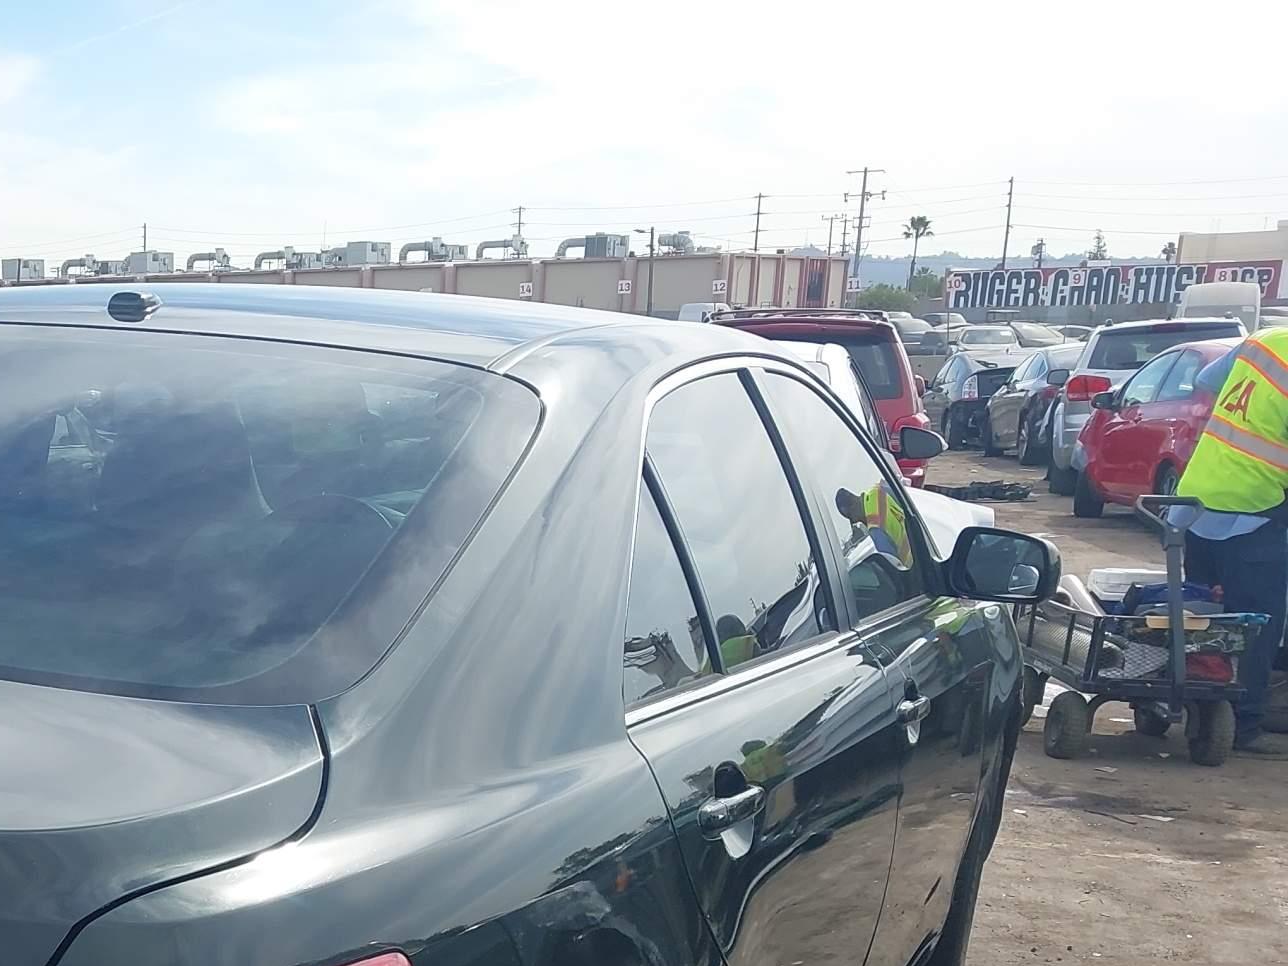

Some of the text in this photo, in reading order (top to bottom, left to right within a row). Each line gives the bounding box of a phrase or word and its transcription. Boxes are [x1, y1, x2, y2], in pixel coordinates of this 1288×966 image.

[1072, 273, 1081, 285] 9
[1218, 270, 1227, 282] 8
[619, 282, 631, 292] 13
[713, 282, 726, 292] 12
[848, 280, 860, 290] 11
[947, 278, 961, 289] 10
[520, 285, 532, 294] 14
